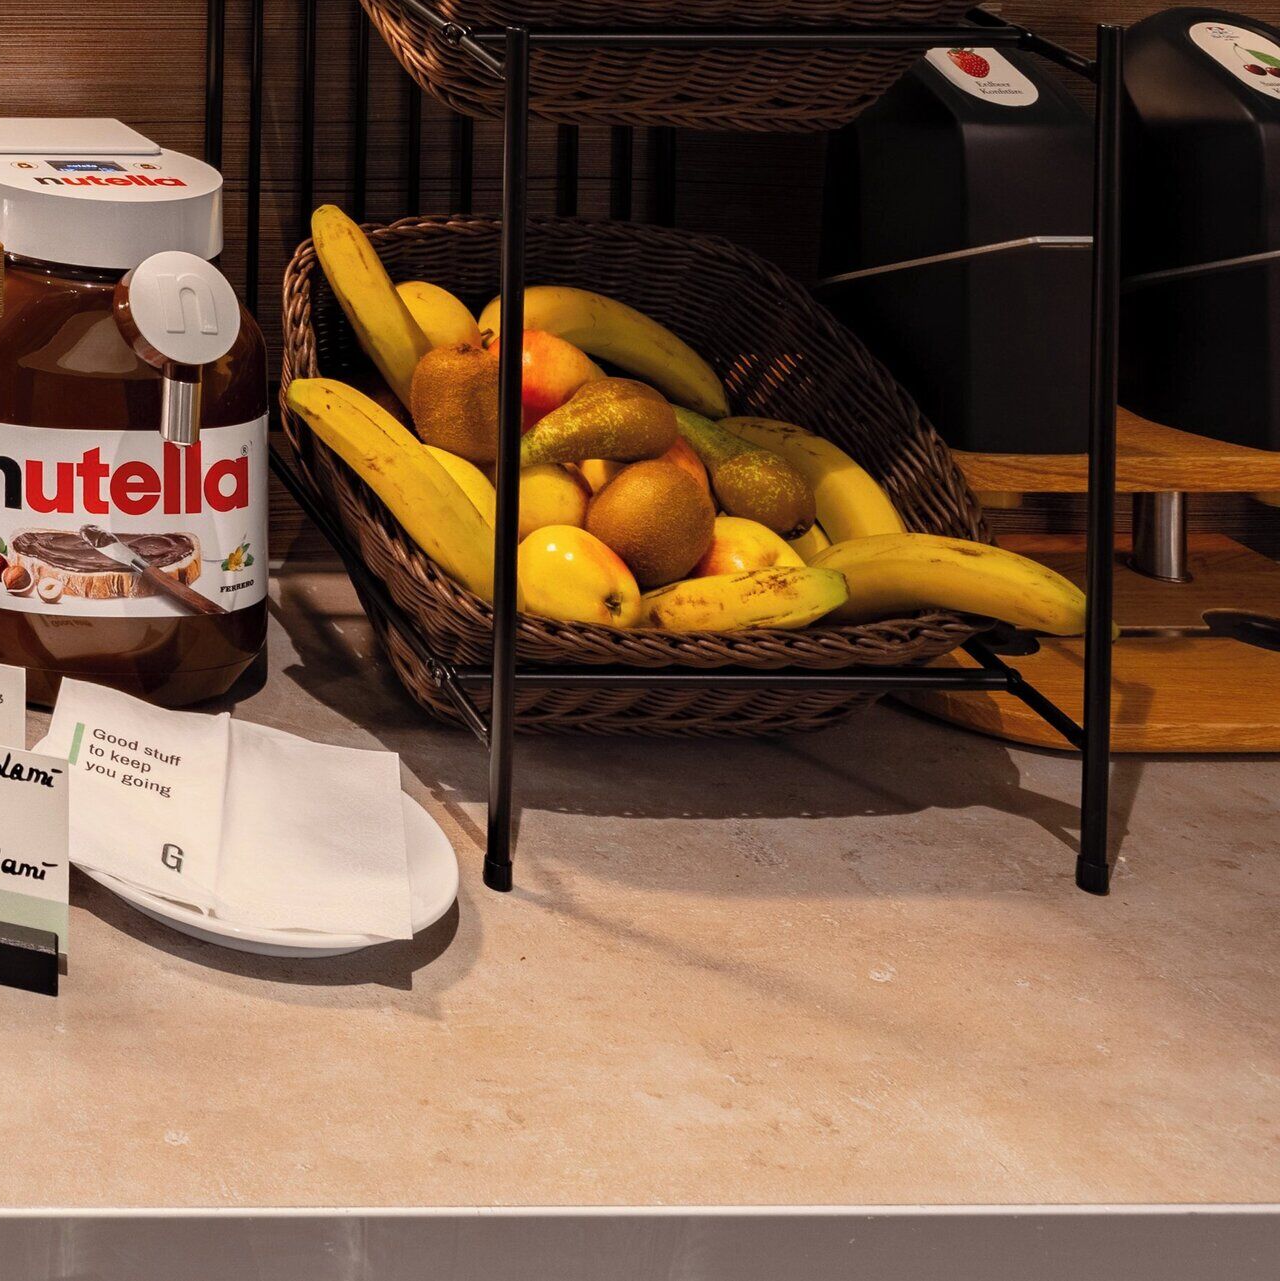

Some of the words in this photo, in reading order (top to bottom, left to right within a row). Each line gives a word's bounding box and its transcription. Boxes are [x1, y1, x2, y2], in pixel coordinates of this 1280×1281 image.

[33, 174, 188, 187] nutella
[219, 577, 255, 594] FERRERO
[89, 744, 104, 757] to
[111, 750, 151, 773] keep
[93, 728, 138, 751] Good
[144, 746, 182, 766] stuff
[85, 761, 120, 778] you
[121, 775, 171, 798] going
[162, 843, 184, 873] G
